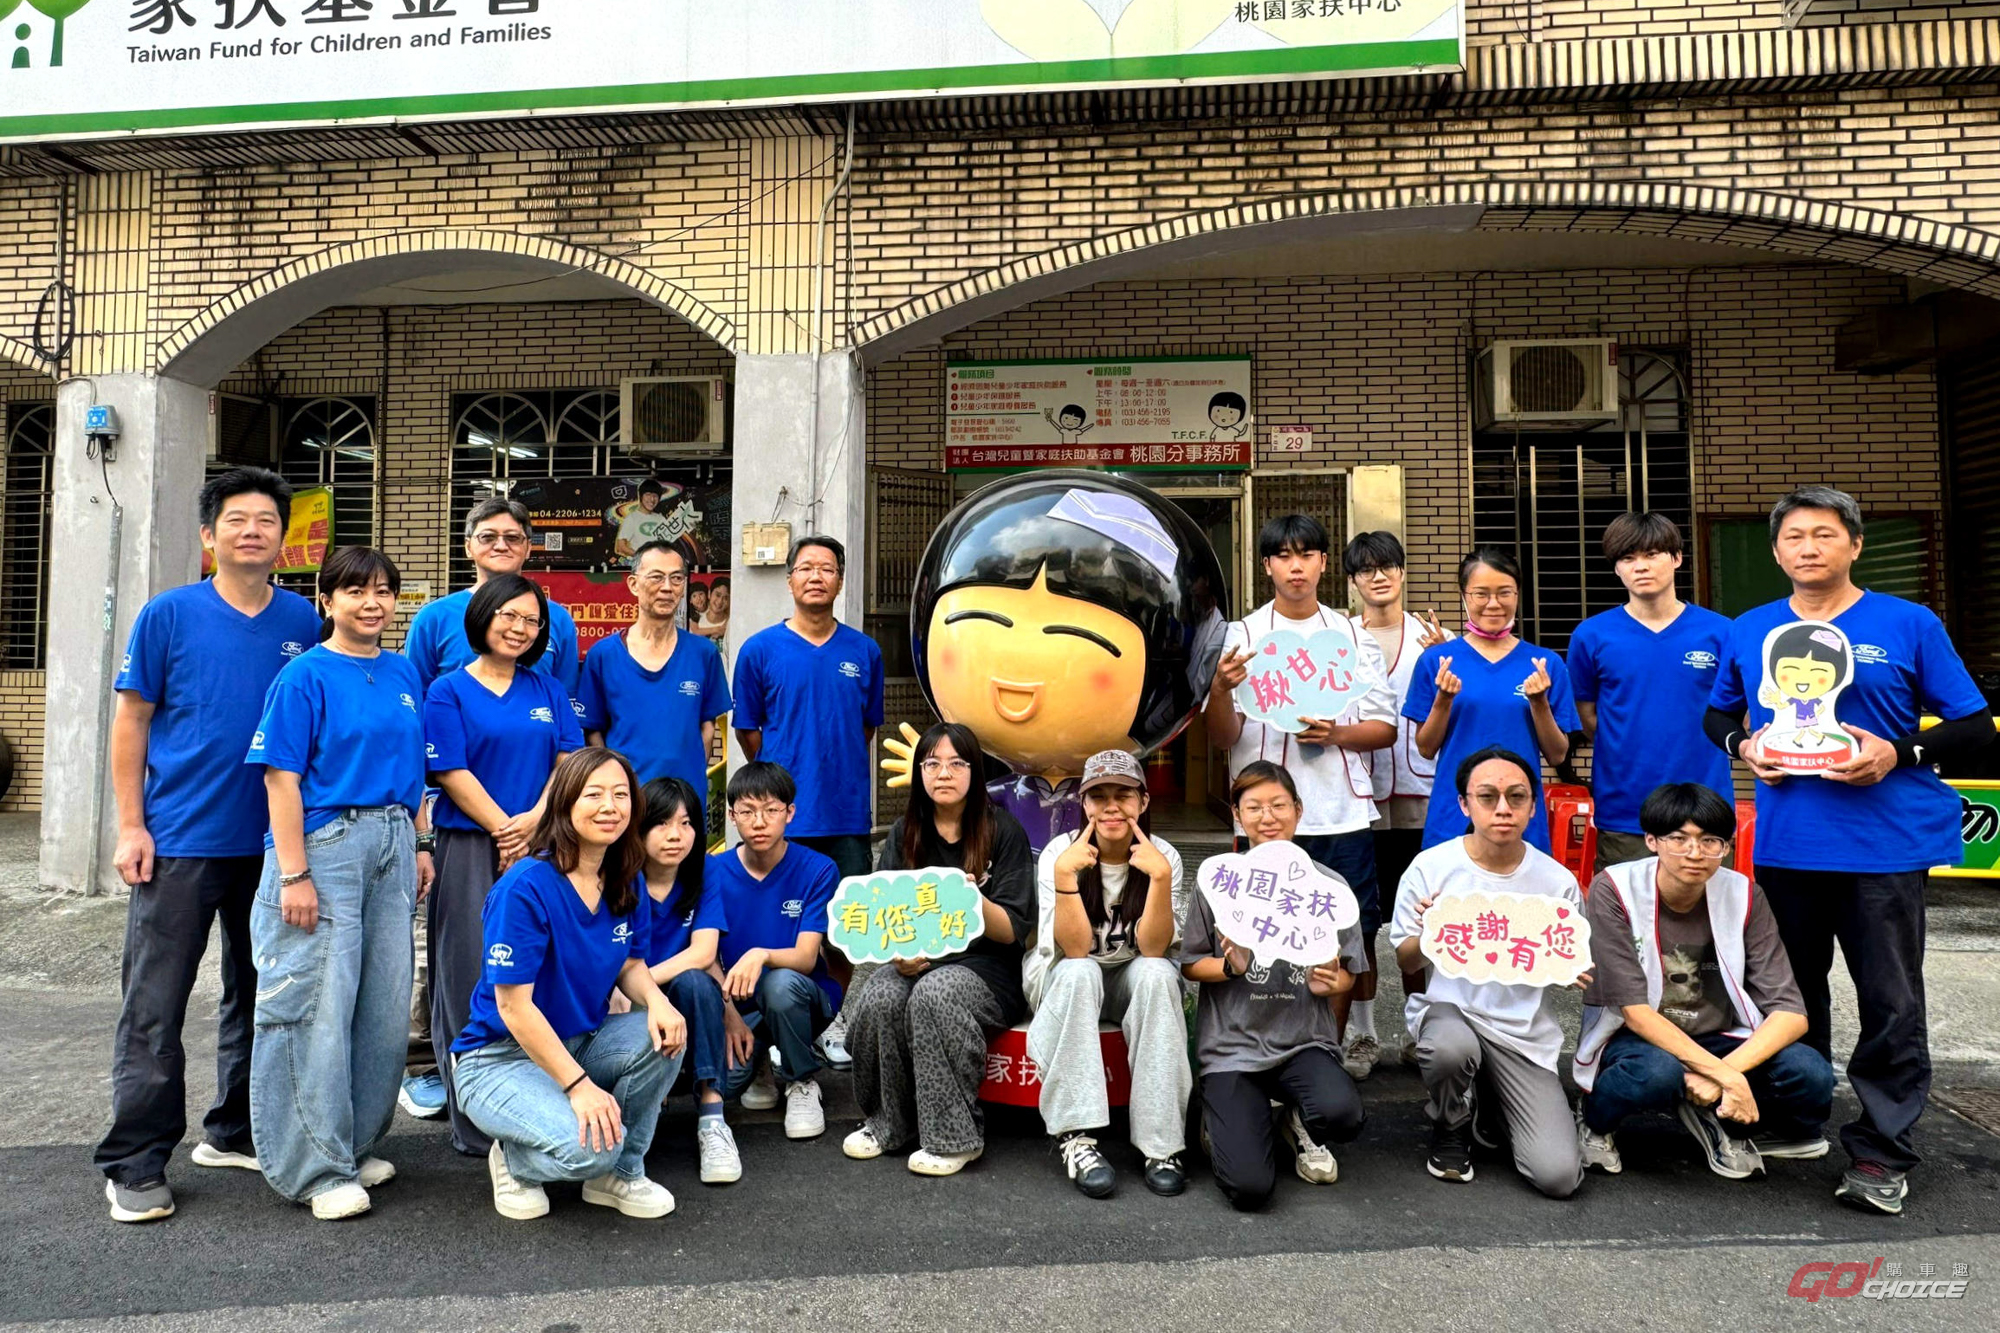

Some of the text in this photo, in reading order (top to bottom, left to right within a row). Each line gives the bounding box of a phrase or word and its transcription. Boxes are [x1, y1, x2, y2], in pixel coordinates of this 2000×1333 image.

[1234, 0, 1401, 23] 桃園家扶中心
[127, 22, 552, 63] Taiwan Fund for Children and Families
[1171, 431, 1208, 440] T.F.C.F.
[1285, 437, 1303, 450] 29
[1129, 444, 1241, 464] 桃園分事務所
[540, 509, 602, 518] 04-2206-1234
[561, 603, 639, 619] 門讓愛住
[1210, 864, 1337, 922] 桃園家扶
[840, 882, 967, 950] 有您真好
[1252, 916, 1308, 950] 中心
[1433, 910, 1576, 973] 感謝有您
